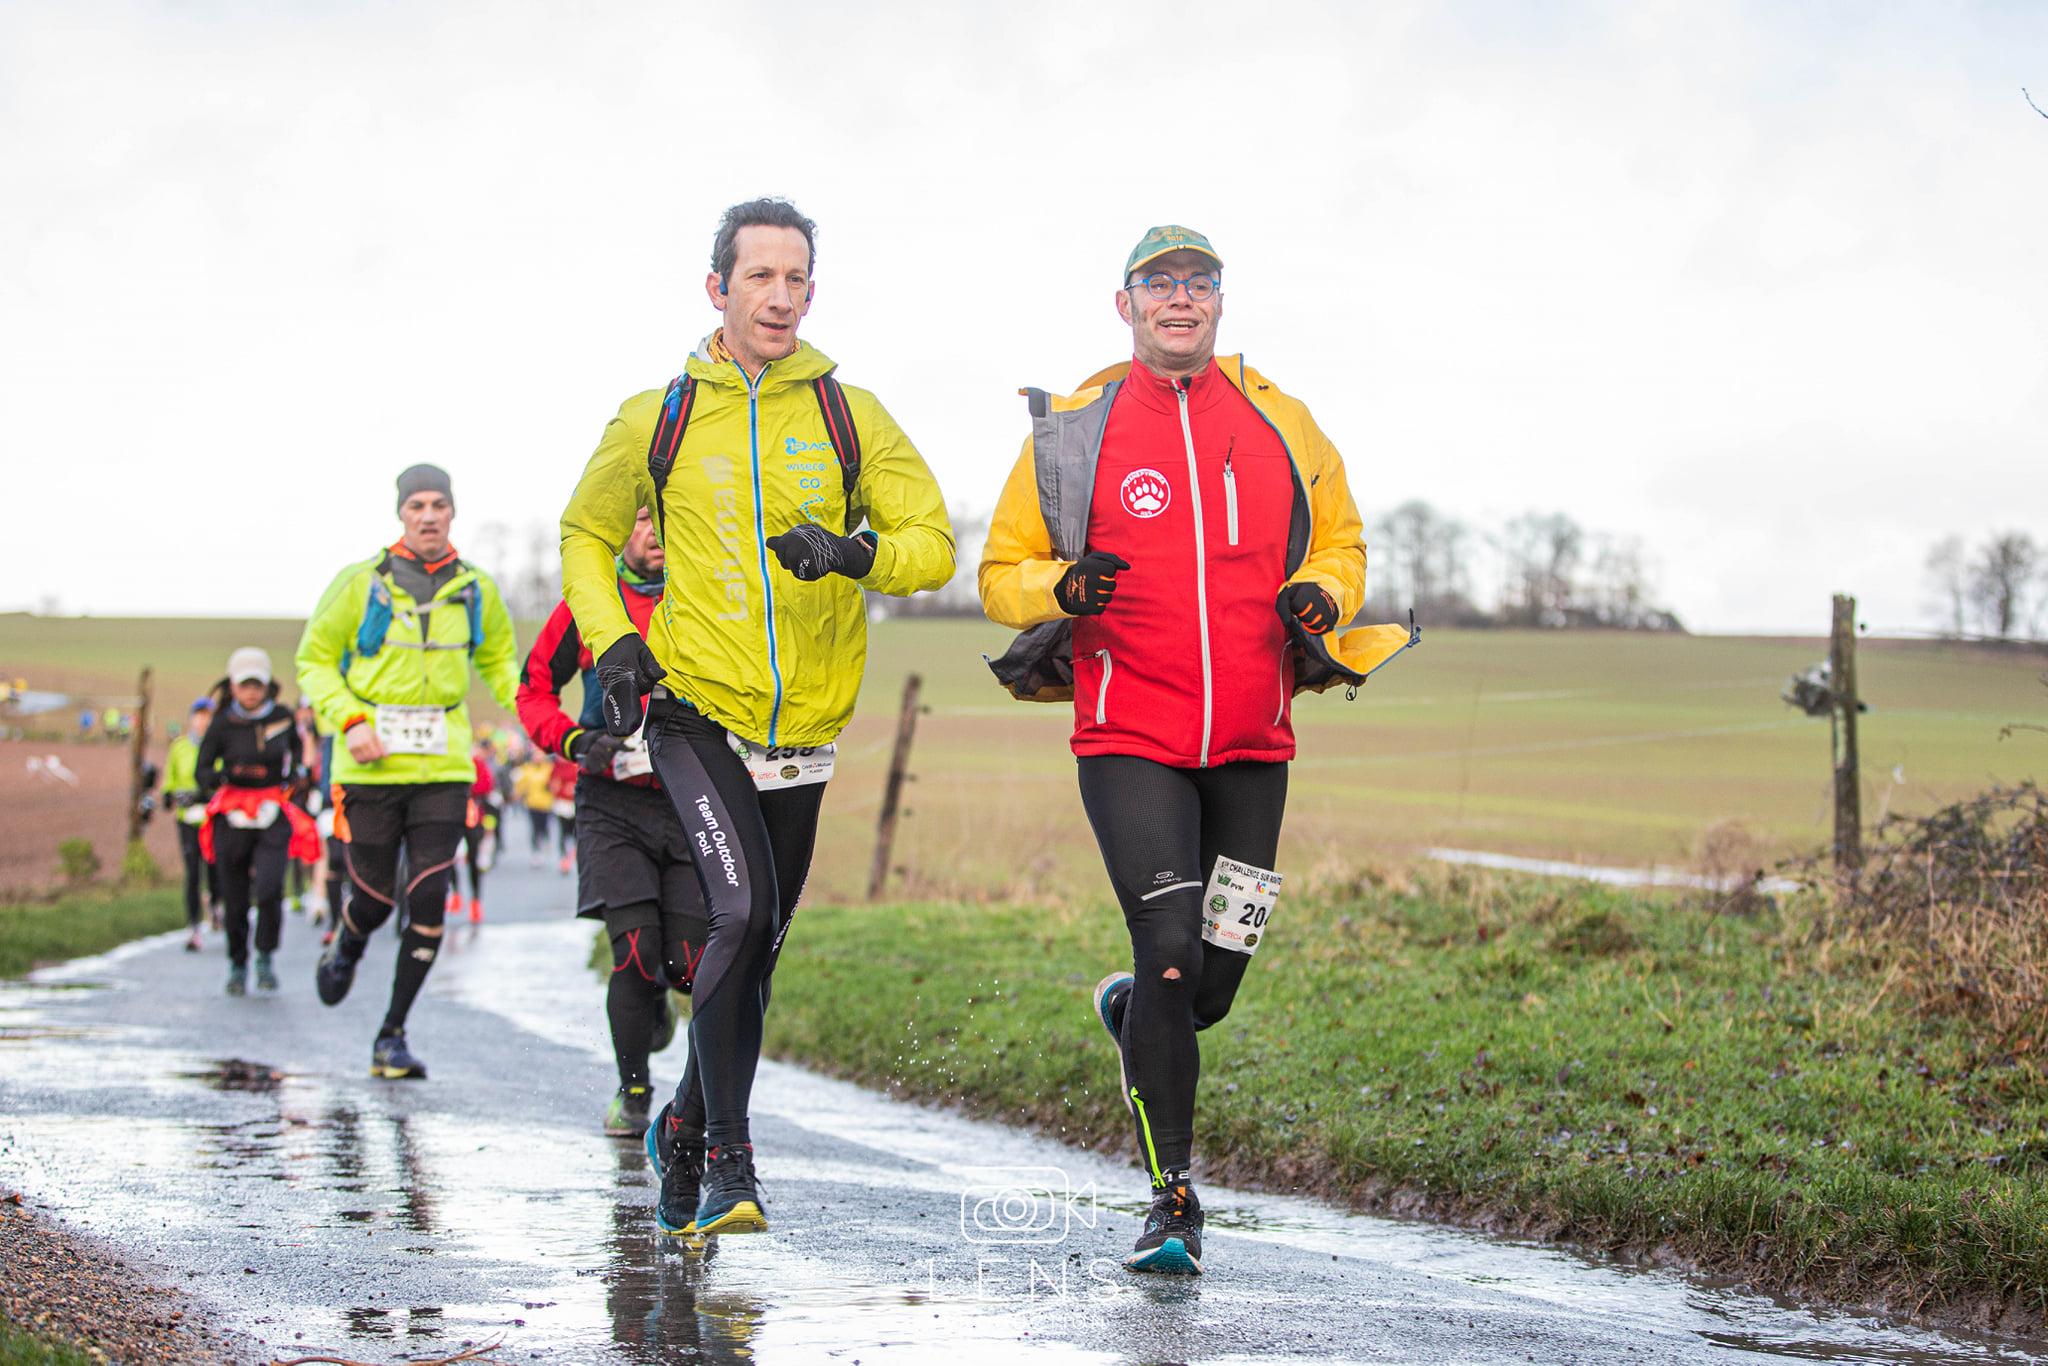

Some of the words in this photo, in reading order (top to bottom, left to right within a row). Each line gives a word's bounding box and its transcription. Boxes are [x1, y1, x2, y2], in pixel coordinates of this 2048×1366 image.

[695, 794, 719, 830] Team
[712, 831, 739, 887] Outdoor
[1229, 863, 1260, 880] CHALLENGE
